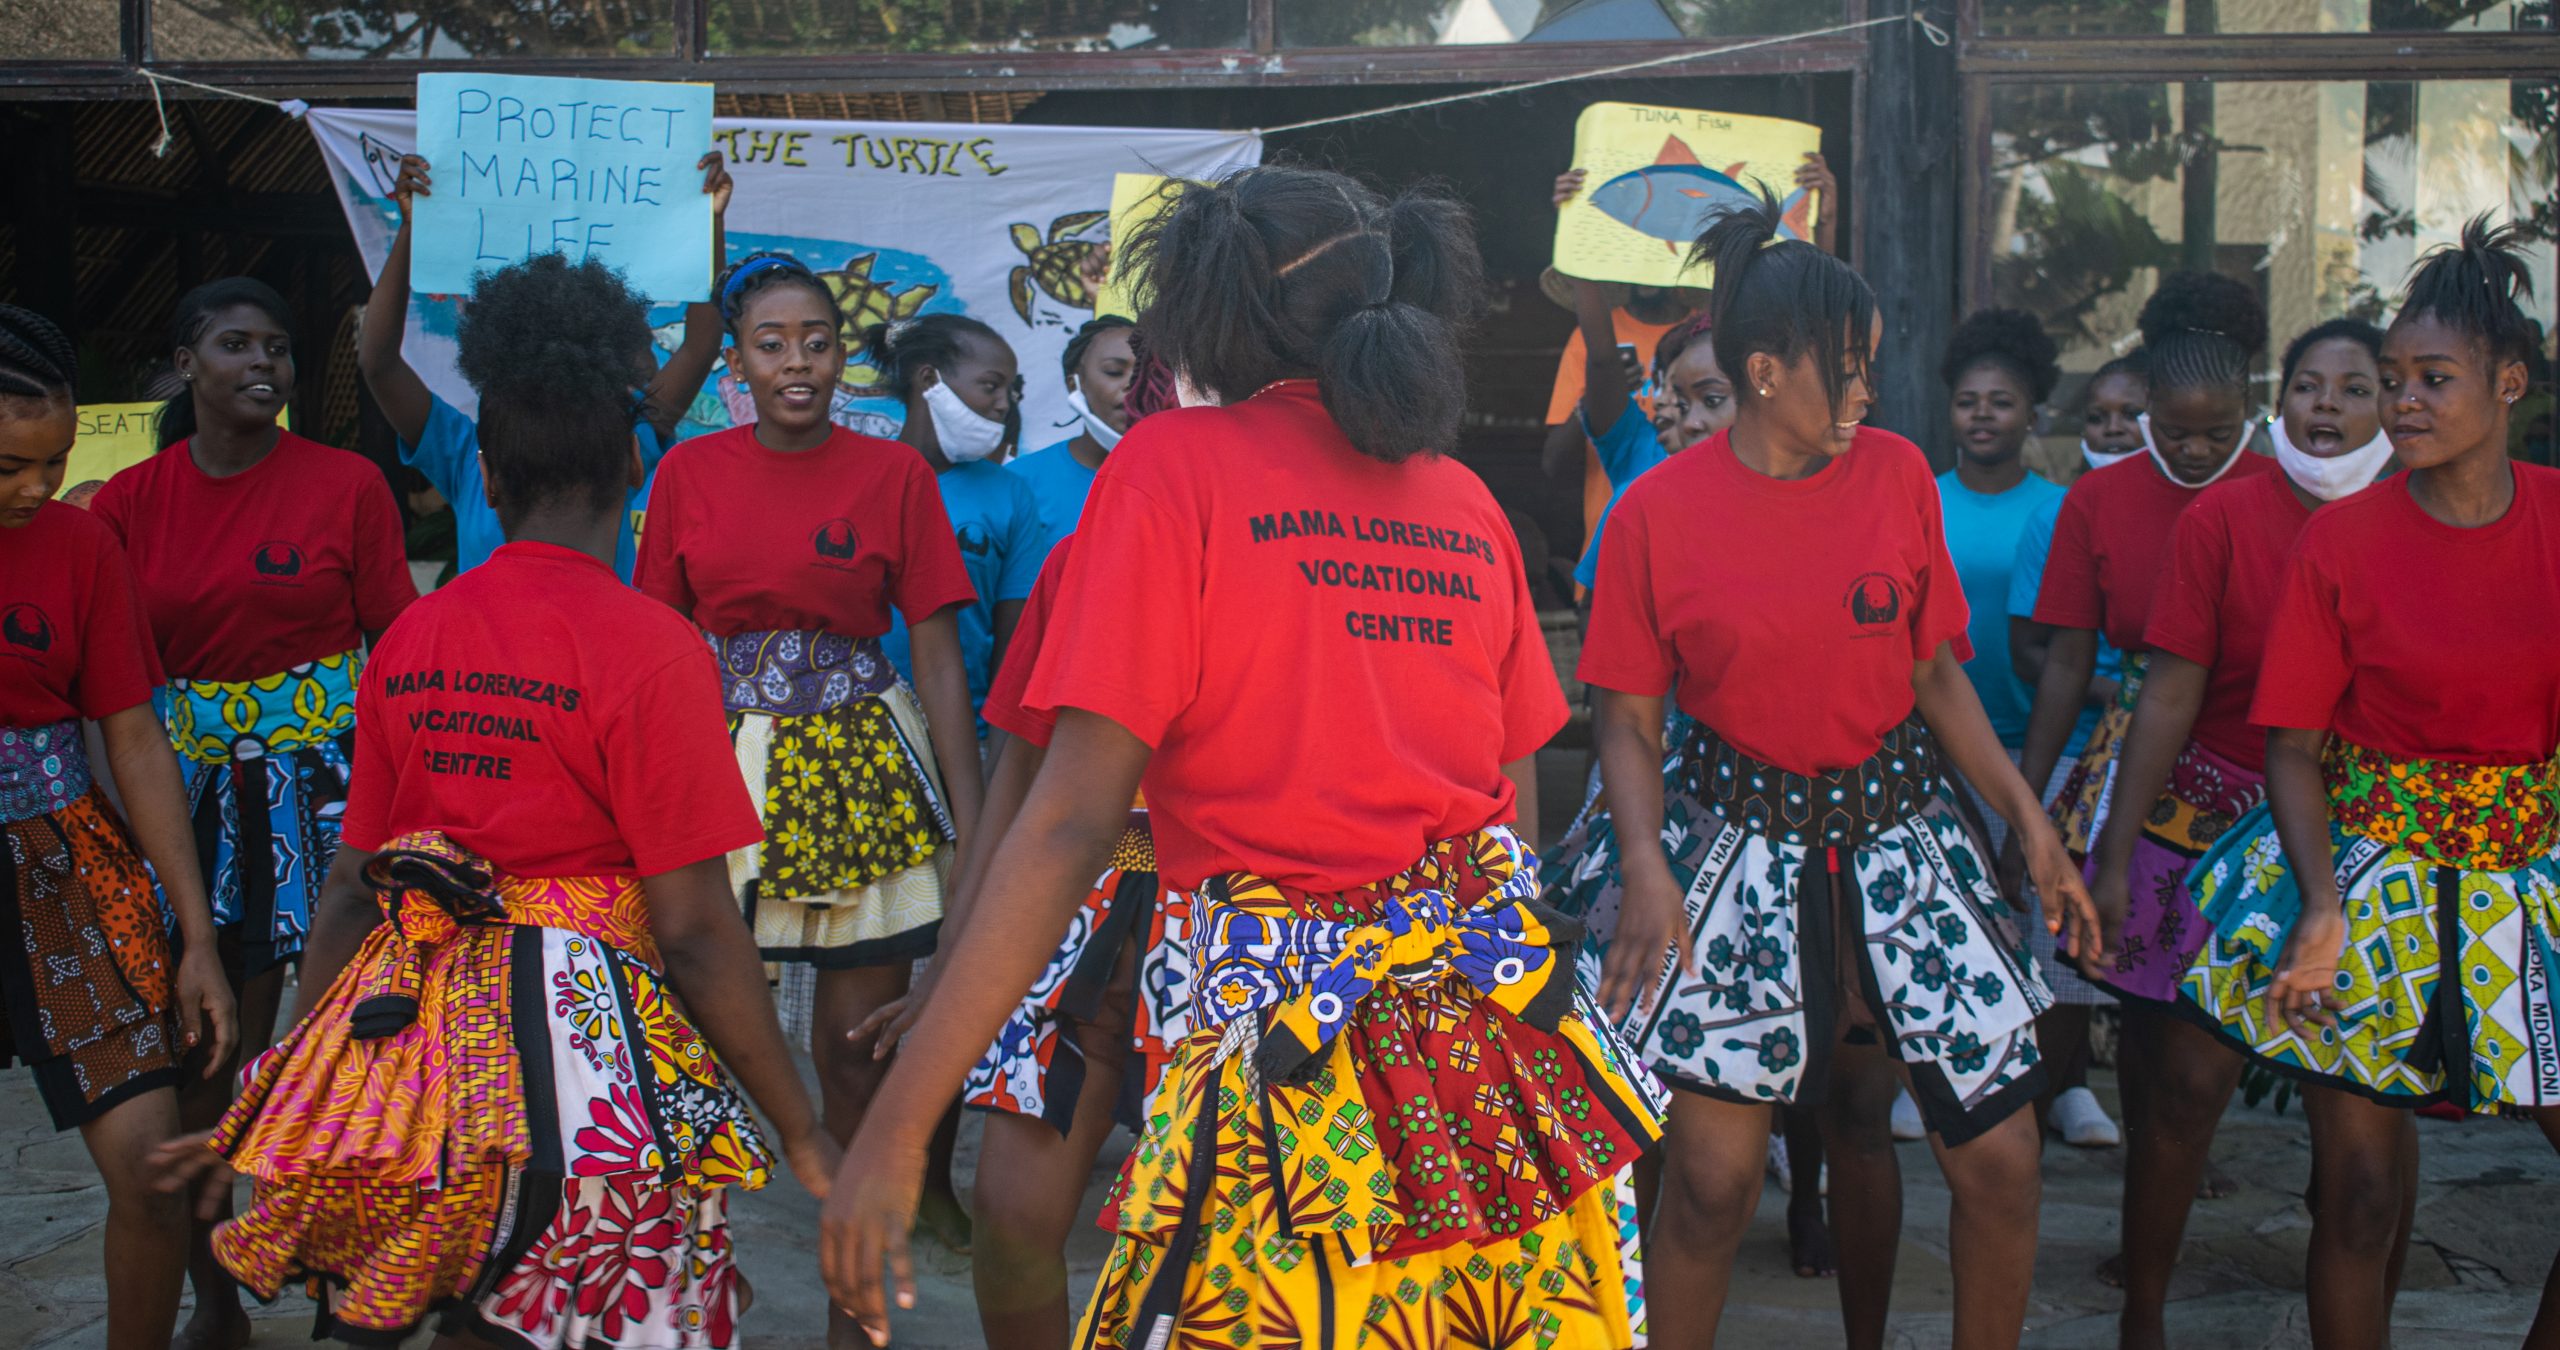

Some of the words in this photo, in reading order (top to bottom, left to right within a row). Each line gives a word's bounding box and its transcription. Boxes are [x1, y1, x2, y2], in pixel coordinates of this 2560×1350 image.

[457, 89, 685, 148] PROTECT
[1629, 107, 1682, 125] TUNA
[713, 128, 811, 167] THE
[832, 132, 1008, 176] TURTLE
[461, 151, 661, 206] MARINE
[1249, 510, 1346, 543] MAMA
[1352, 515, 1495, 565] LORENZA'S
[1298, 560, 1481, 603] VOCATIONAL
[1346, 611, 1453, 646] CENTRE
[454, 670, 581, 712] LORENZA'S
[424, 749, 512, 780] CENTRE
[1695, 870, 1716, 895] WA
[2532, 1002, 2559, 1096] MDOMONI
